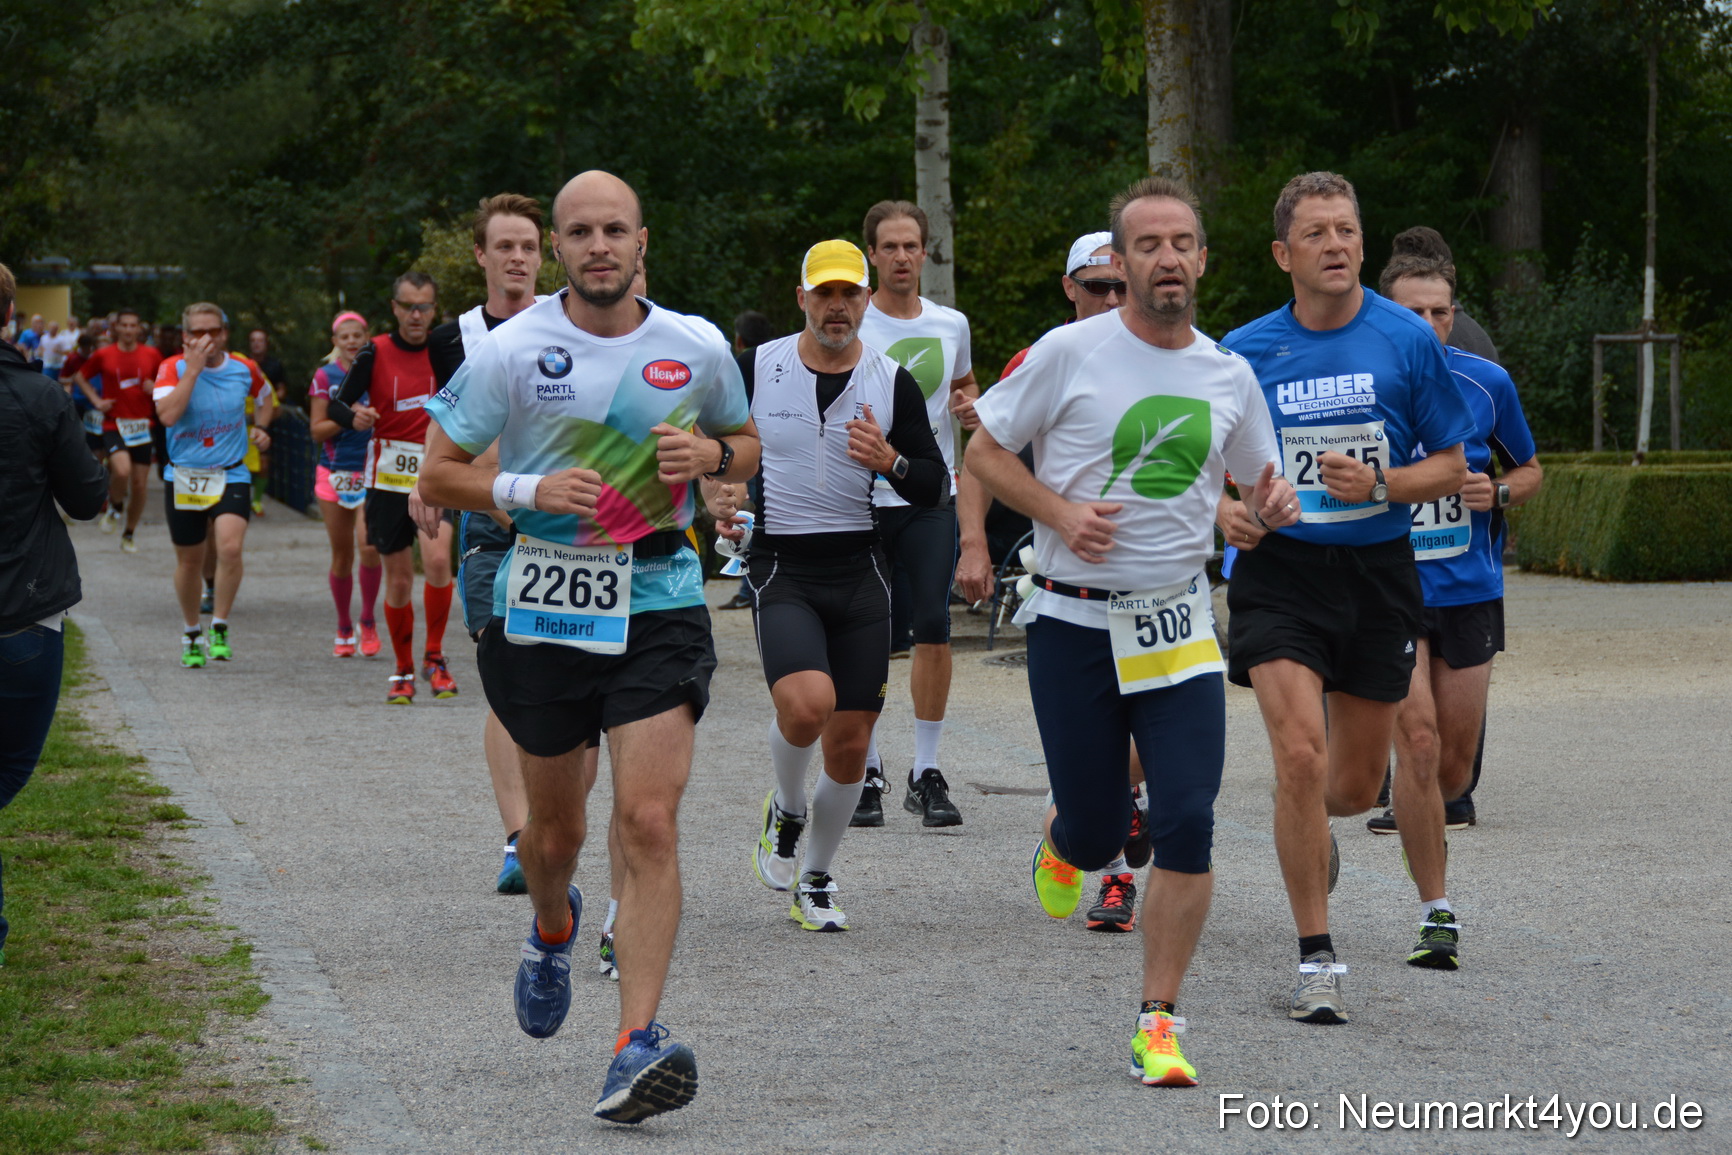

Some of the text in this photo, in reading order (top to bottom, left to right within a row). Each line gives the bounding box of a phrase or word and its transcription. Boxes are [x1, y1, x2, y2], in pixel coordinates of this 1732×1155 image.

[649, 366, 687, 383] Hervis
[536, 384, 576, 394] PARTL
[1276, 373, 1375, 404] HUBER
[537, 393, 576, 402] Neumarkt
[1297, 395, 1371, 411] TECHNOLOGY
[1298, 407, 1373, 421] WASTE WATER Solutions
[1285, 433, 1371, 446] PARTL Neumarkt
[396, 454, 418, 474] 98
[189, 477, 210, 493] 57
[1410, 535, 1455, 549] olfgang
[517, 545, 610, 564] PARTL Neumarkt
[631, 561, 672, 574] Stadtlauf
[519, 562, 619, 610] 2263
[511, 598, 516, 607] B
[1110, 599, 1149, 610] PARTL
[534, 616, 595, 637] Richard
[1135, 603, 1192, 648] 508
